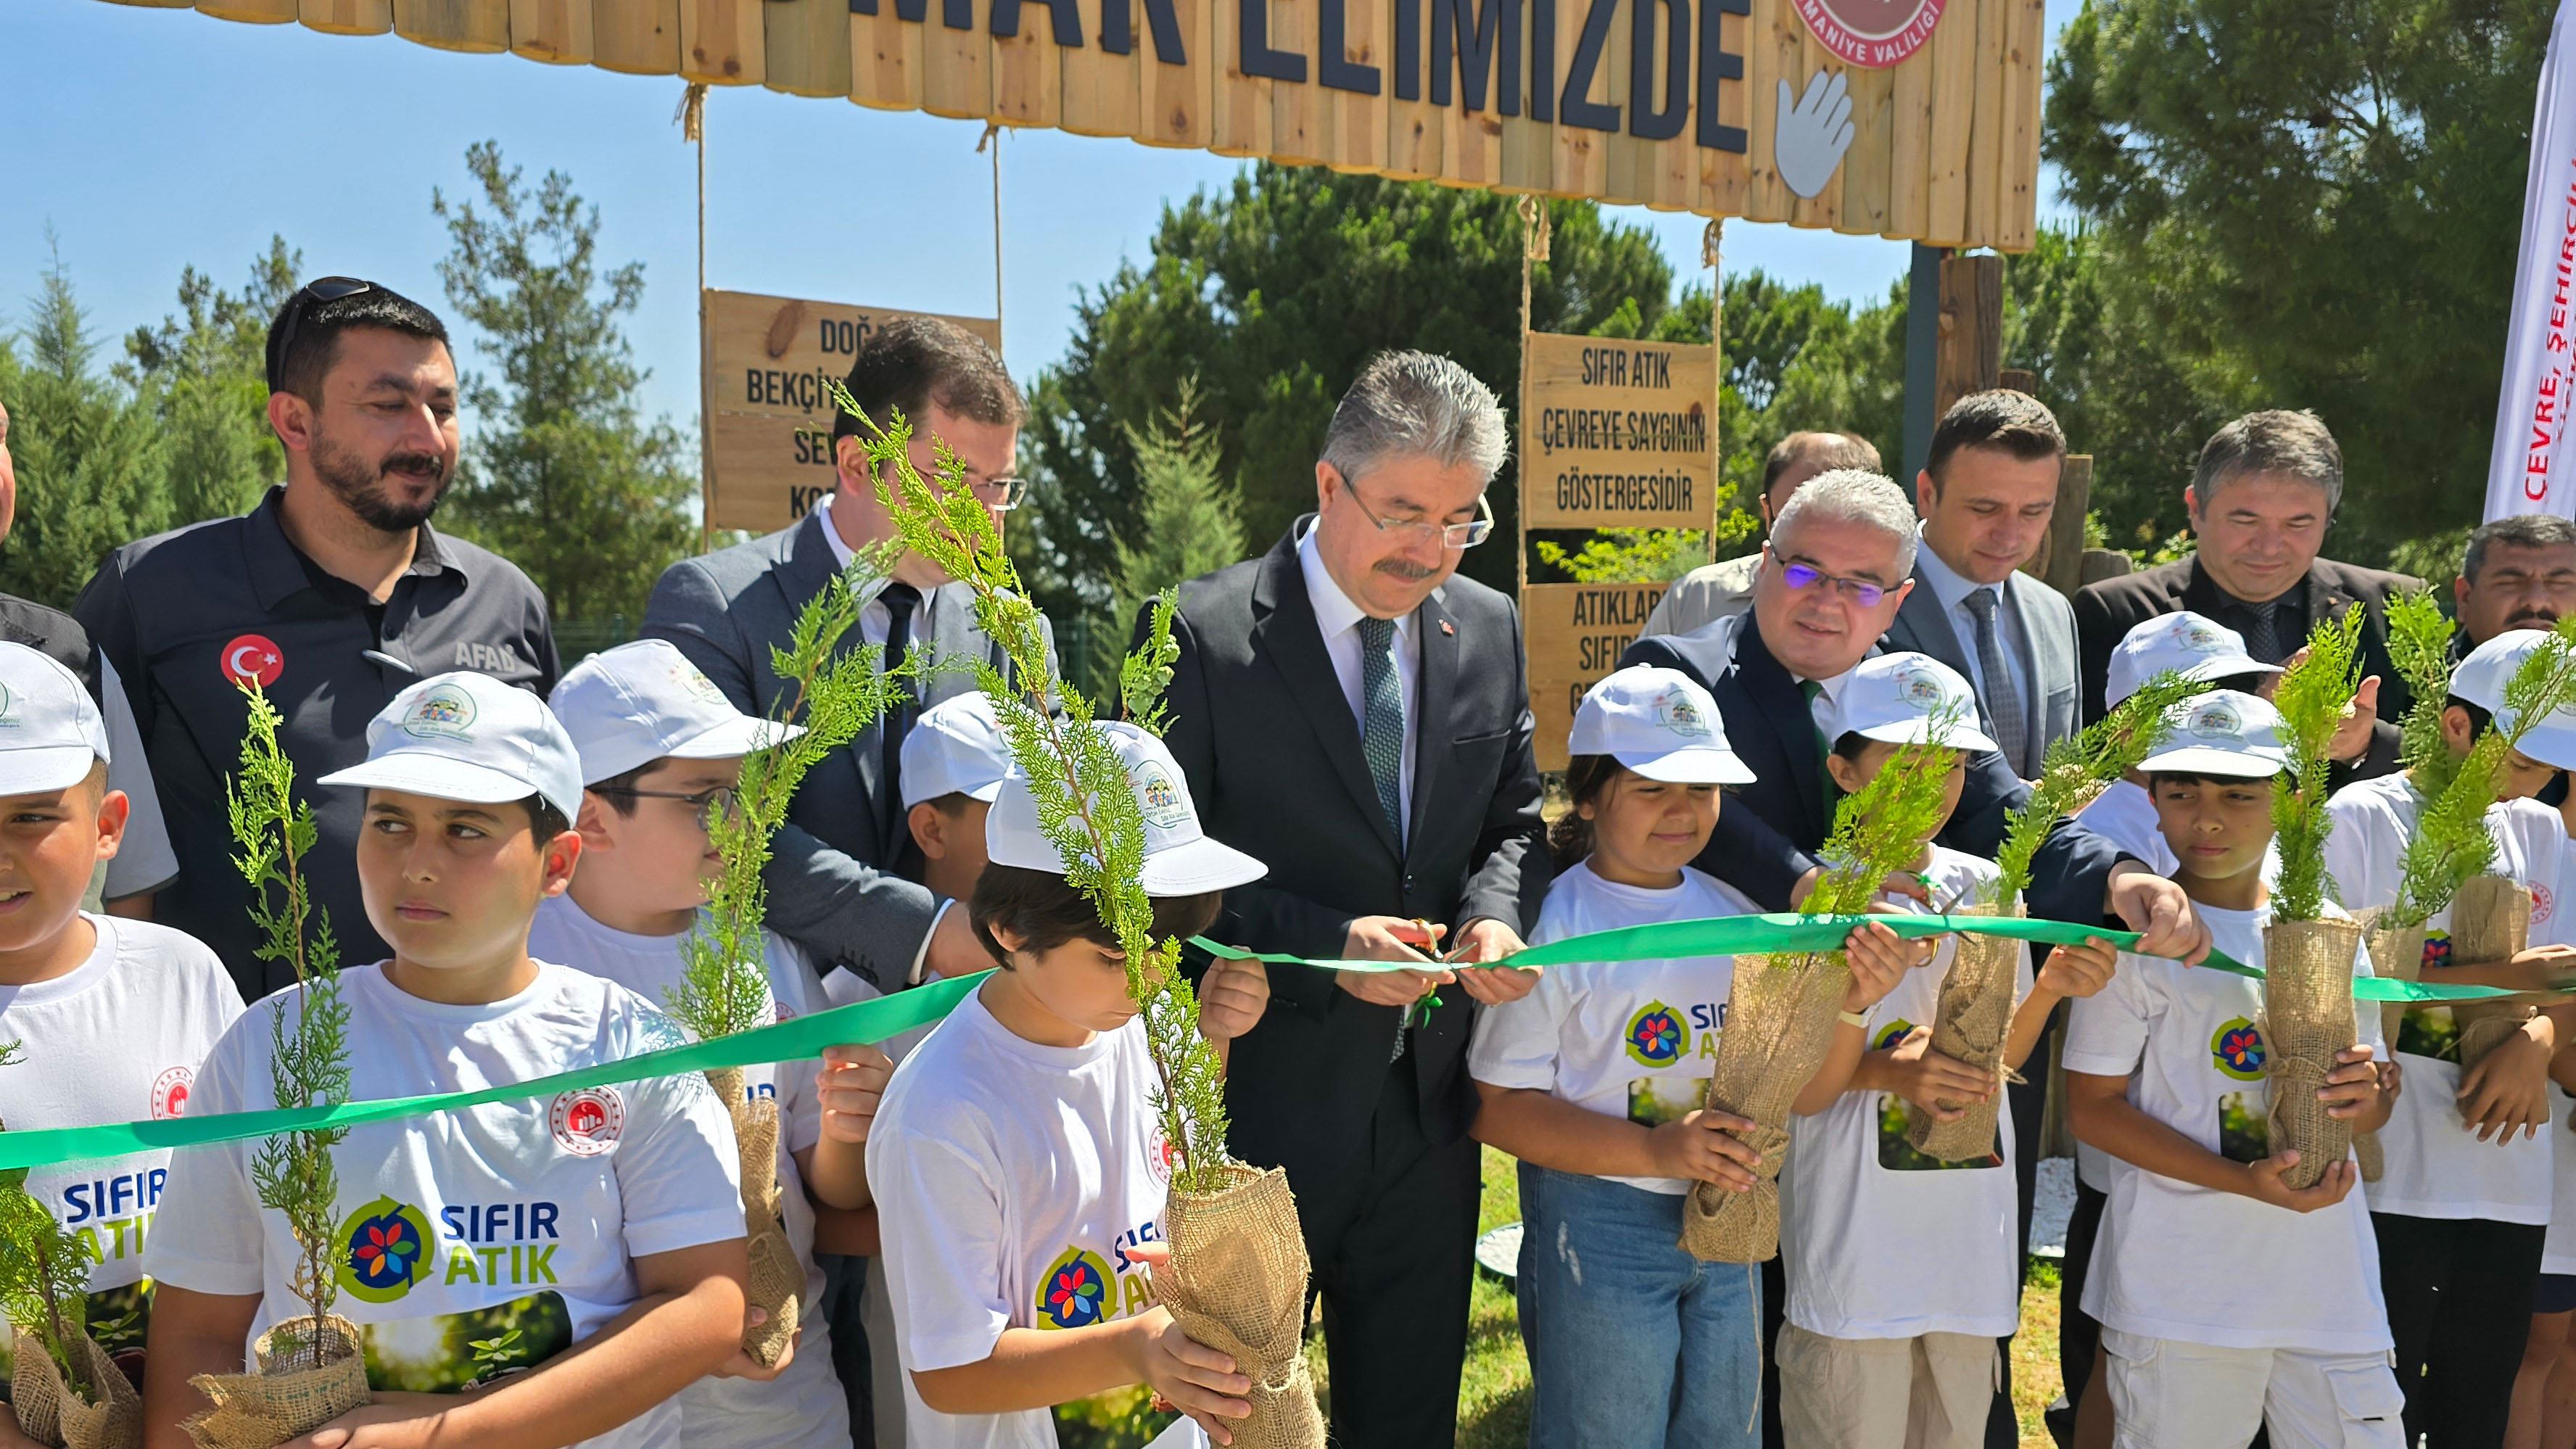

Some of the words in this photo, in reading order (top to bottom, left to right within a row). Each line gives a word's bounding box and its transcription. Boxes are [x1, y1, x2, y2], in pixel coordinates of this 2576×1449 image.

[1797, 0, 1867, 61] MANİYE
[820, 315, 886, 354] DOĞ
[1582, 347, 1627, 386] SIFIR
[1631, 351, 1671, 389] ATIK
[1543, 408, 1622, 455] ÇEVREYE
[1627, 410, 1706, 453] SAYGININ
[1557, 466, 1692, 511] GÖSTERGESİDİR
[1573, 590, 1667, 626] ATIKLAR
[455, 642, 516, 673] AFAD
[75, 1213, 155, 1265] ATI
[441, 1202, 559, 1240] SIFIR
[445, 1244, 559, 1286] ATIK
